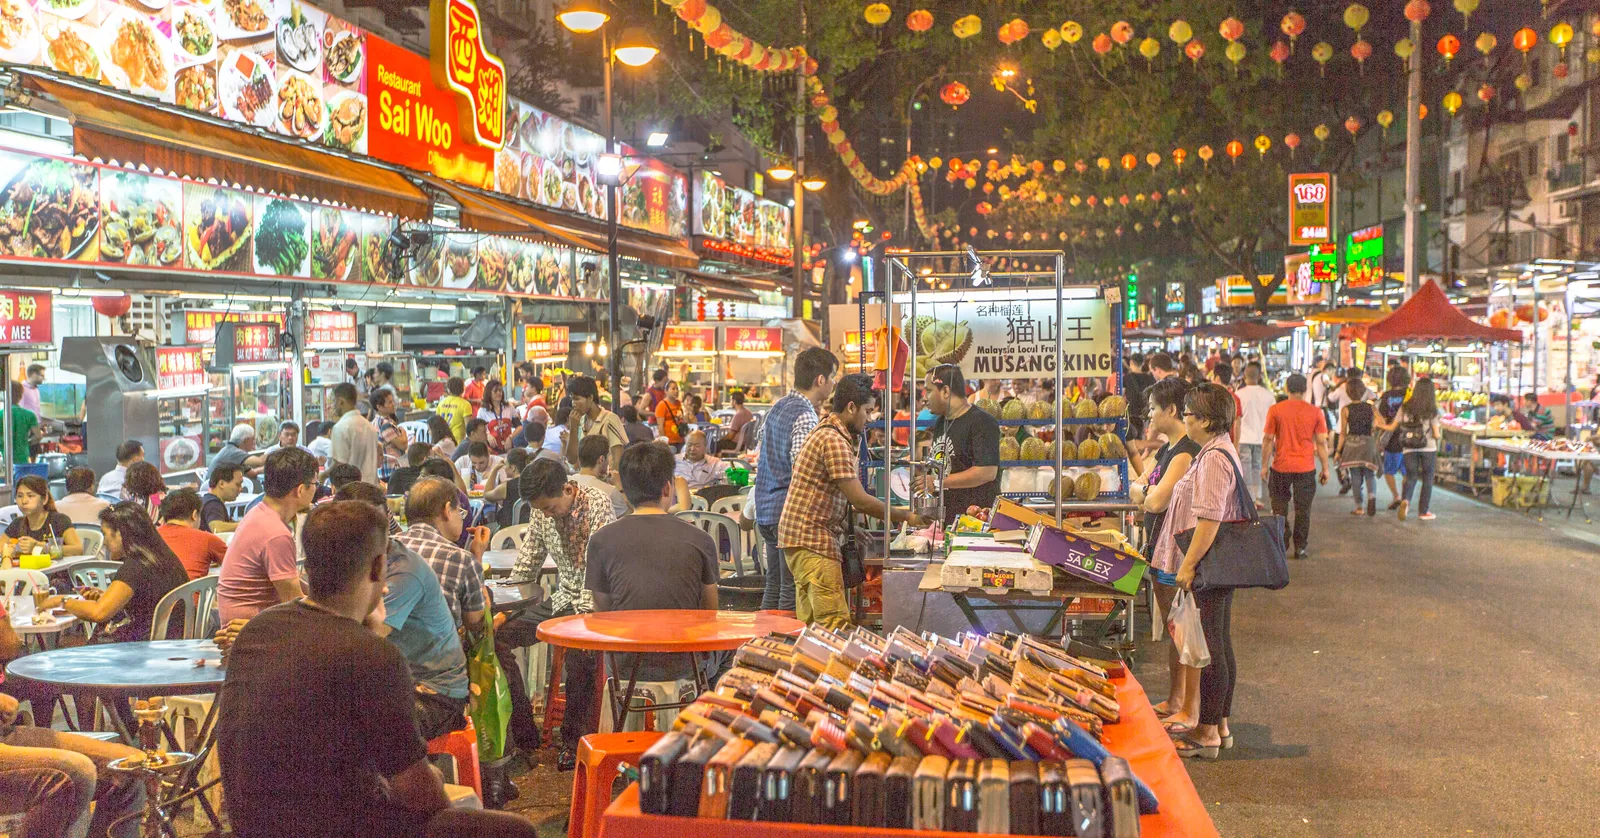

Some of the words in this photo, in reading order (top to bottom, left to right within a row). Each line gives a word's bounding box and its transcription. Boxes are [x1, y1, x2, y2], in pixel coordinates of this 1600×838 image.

[378, 63, 422, 97] Restaurant
[380, 90, 410, 137] Sai
[415, 101, 452, 149] Woo
[1294, 184, 1326, 203] 168
[976, 304, 1024, 317] 名种榴莲
[11, 325, 31, 340] MEE
[1006, 315, 1094, 344] 猫山王
[734, 340, 773, 351] SATAY
[977, 345, 1015, 355] Malaysia
[1018, 344, 1038, 354] Local
[1041, 344, 1059, 353] Frui
[973, 354, 1057, 373] MUSANG
[1063, 353, 1112, 372] KING
[1066, 552, 1111, 576] SAPEX
